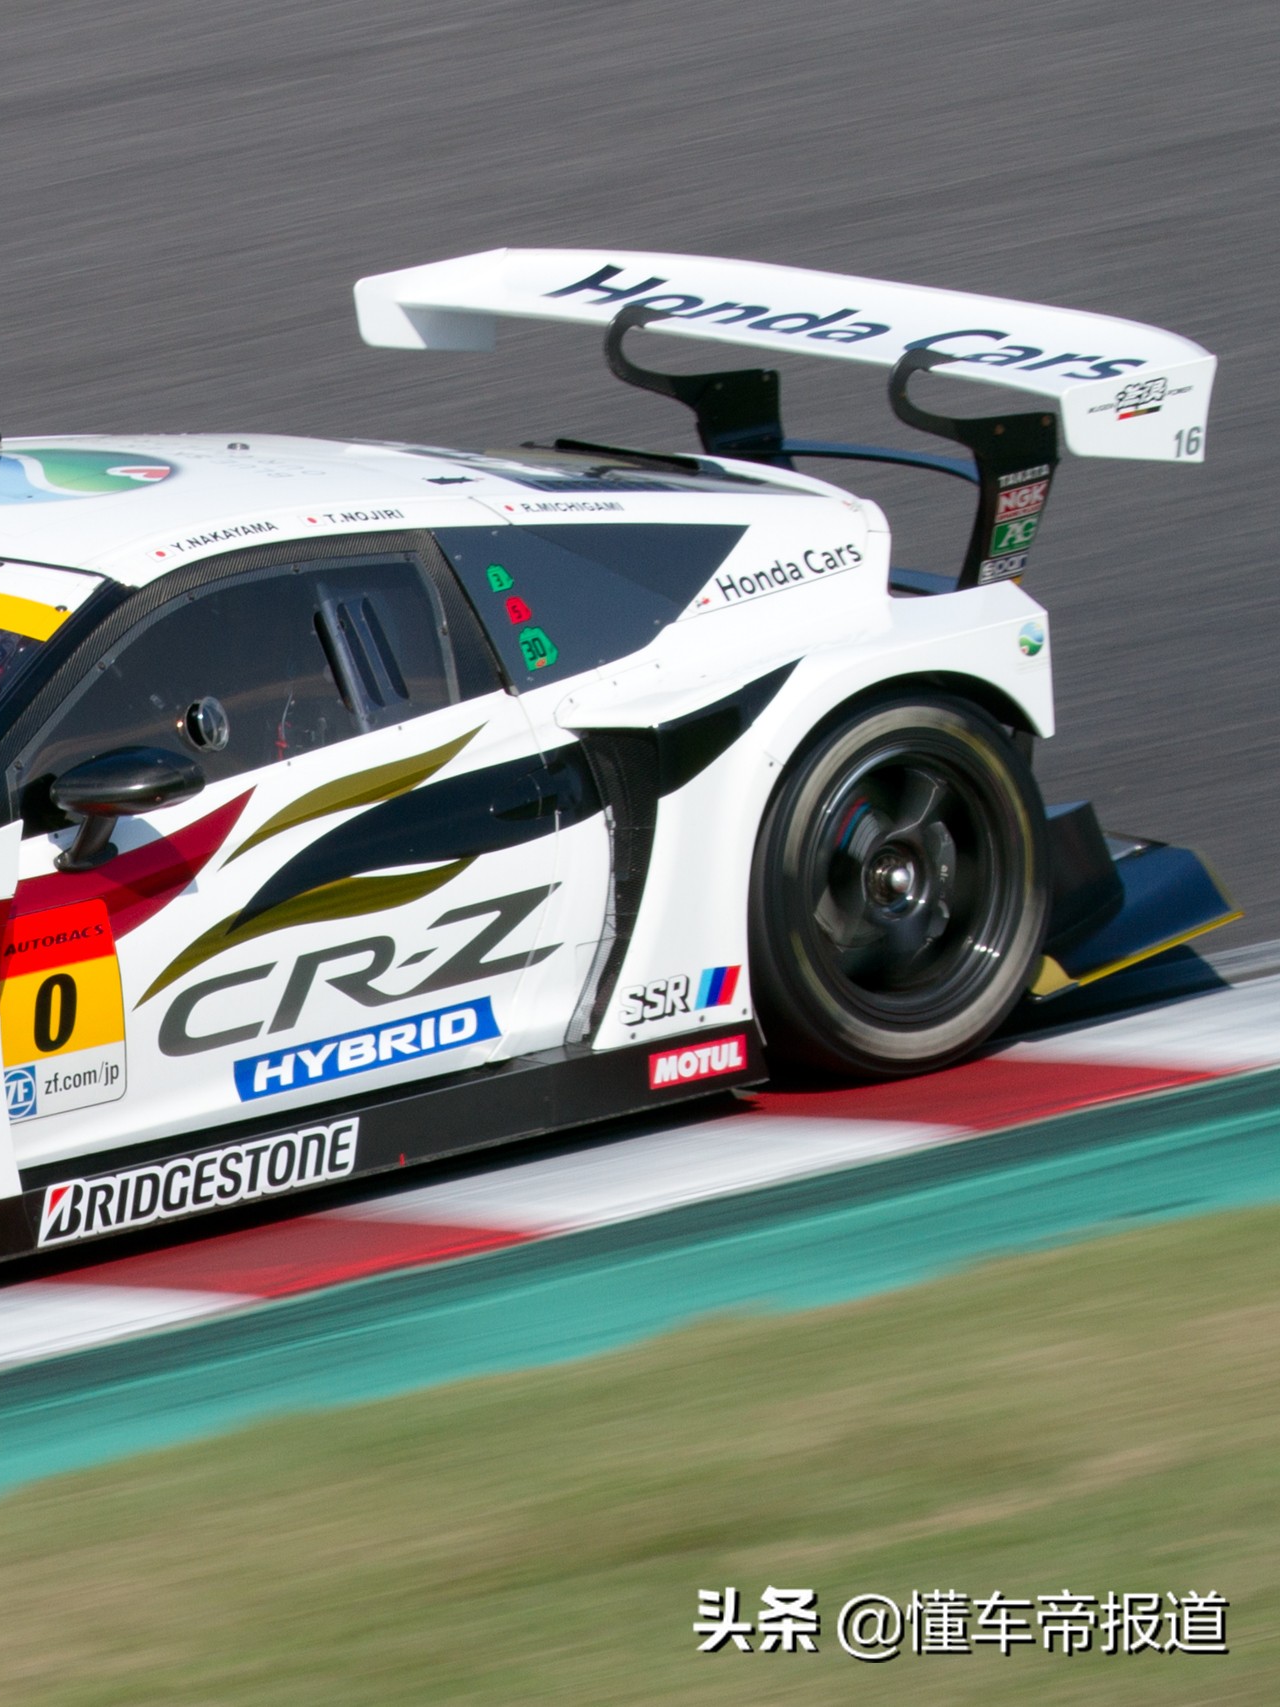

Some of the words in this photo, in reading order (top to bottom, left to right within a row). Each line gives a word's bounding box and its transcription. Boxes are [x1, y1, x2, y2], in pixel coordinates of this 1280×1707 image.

[540, 264, 891, 343] Honda
[904, 329, 1148, 380] Cars
[1174, 426, 1202, 459] 16
[324, 508, 406, 524] T.NOJIRI
[521, 502, 625, 514] R.MICHIGAMI
[999, 482, 1048, 513] NGK
[171, 521, 280, 552] Y.NAKAYAMA
[715, 560, 804, 602] Honda
[803, 544, 863, 574] Cars
[521, 637, 547, 661] 30
[4, 924, 105, 957] AUTOBACS
[158, 881, 565, 1057] CR-Z
[34, 973, 77, 1053] 0
[619, 974, 691, 1027] SSR
[252, 1007, 478, 1093] HYBRID
[654, 1041, 743, 1084] MOTUL
[44, 1060, 120, 1096] zf.com/jp
[43, 1124, 353, 1242] BRIDGESTONE
